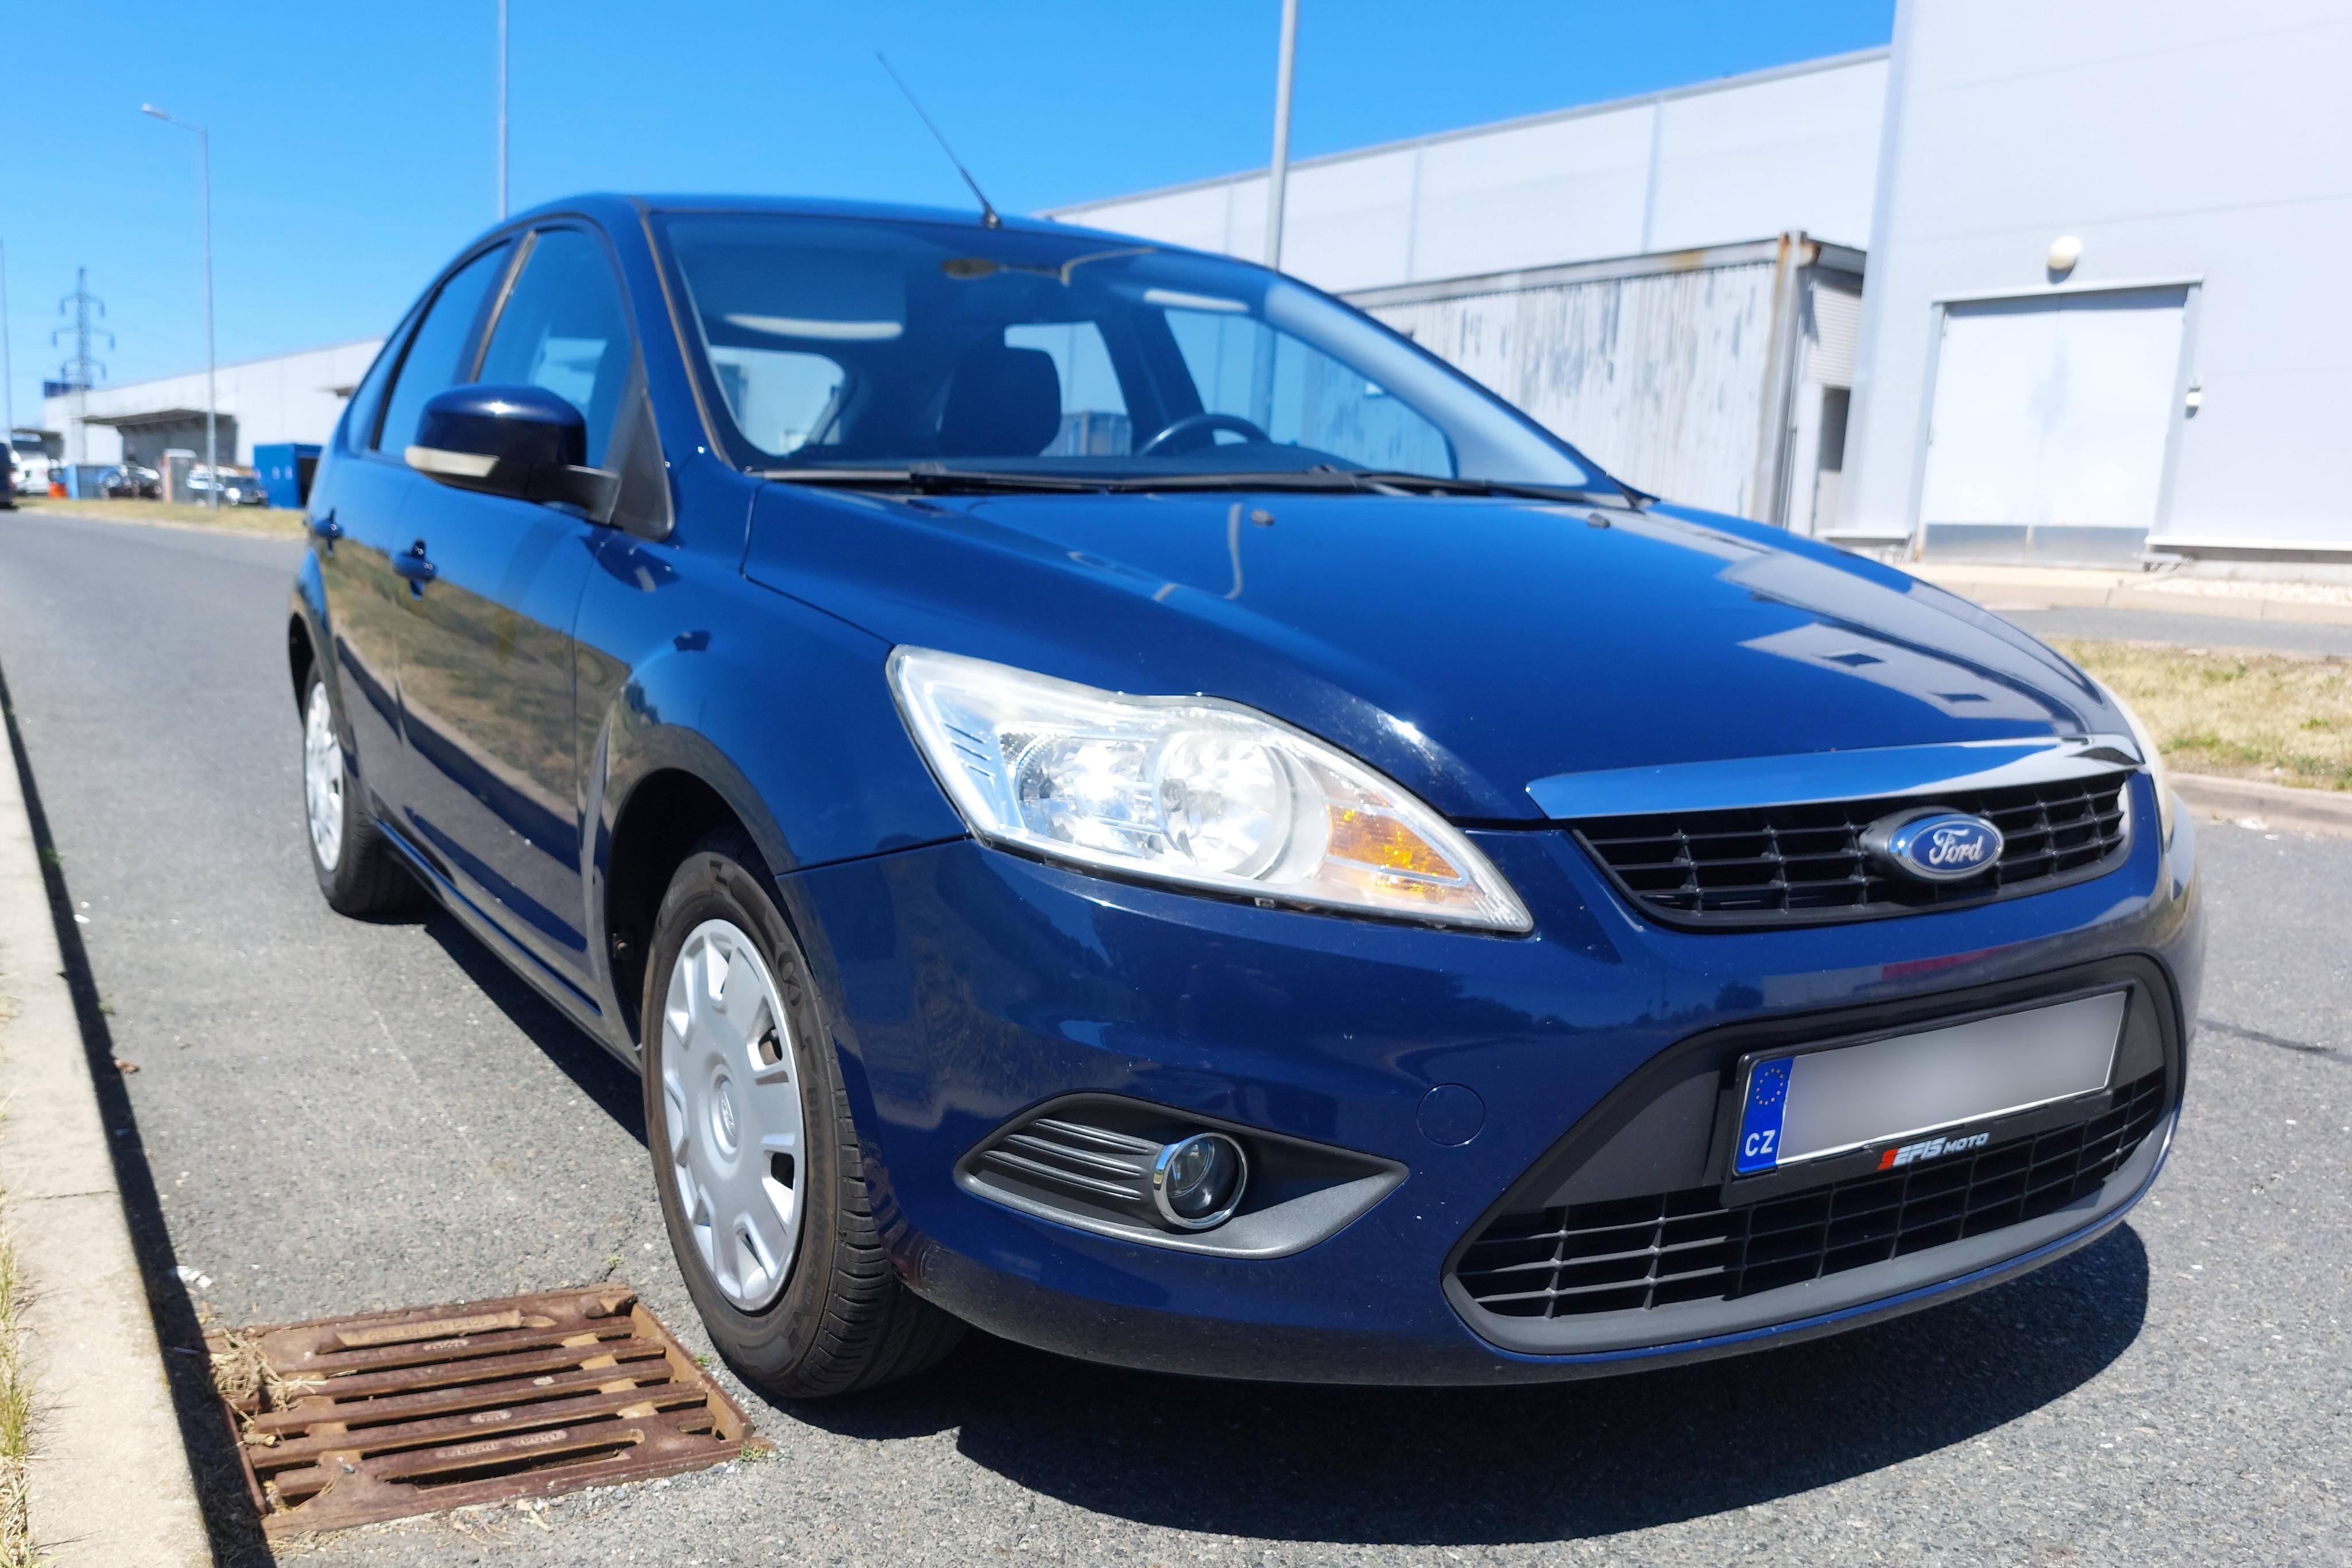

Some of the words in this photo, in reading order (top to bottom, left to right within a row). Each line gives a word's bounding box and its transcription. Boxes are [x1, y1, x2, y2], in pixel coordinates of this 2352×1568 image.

[1929, 828, 1984, 865] Ford
[1745, 1129, 1775, 1156] CZ
[1877, 1136, 1948, 1171] SEFIS
[1942, 1131, 1990, 1155] MOTO
